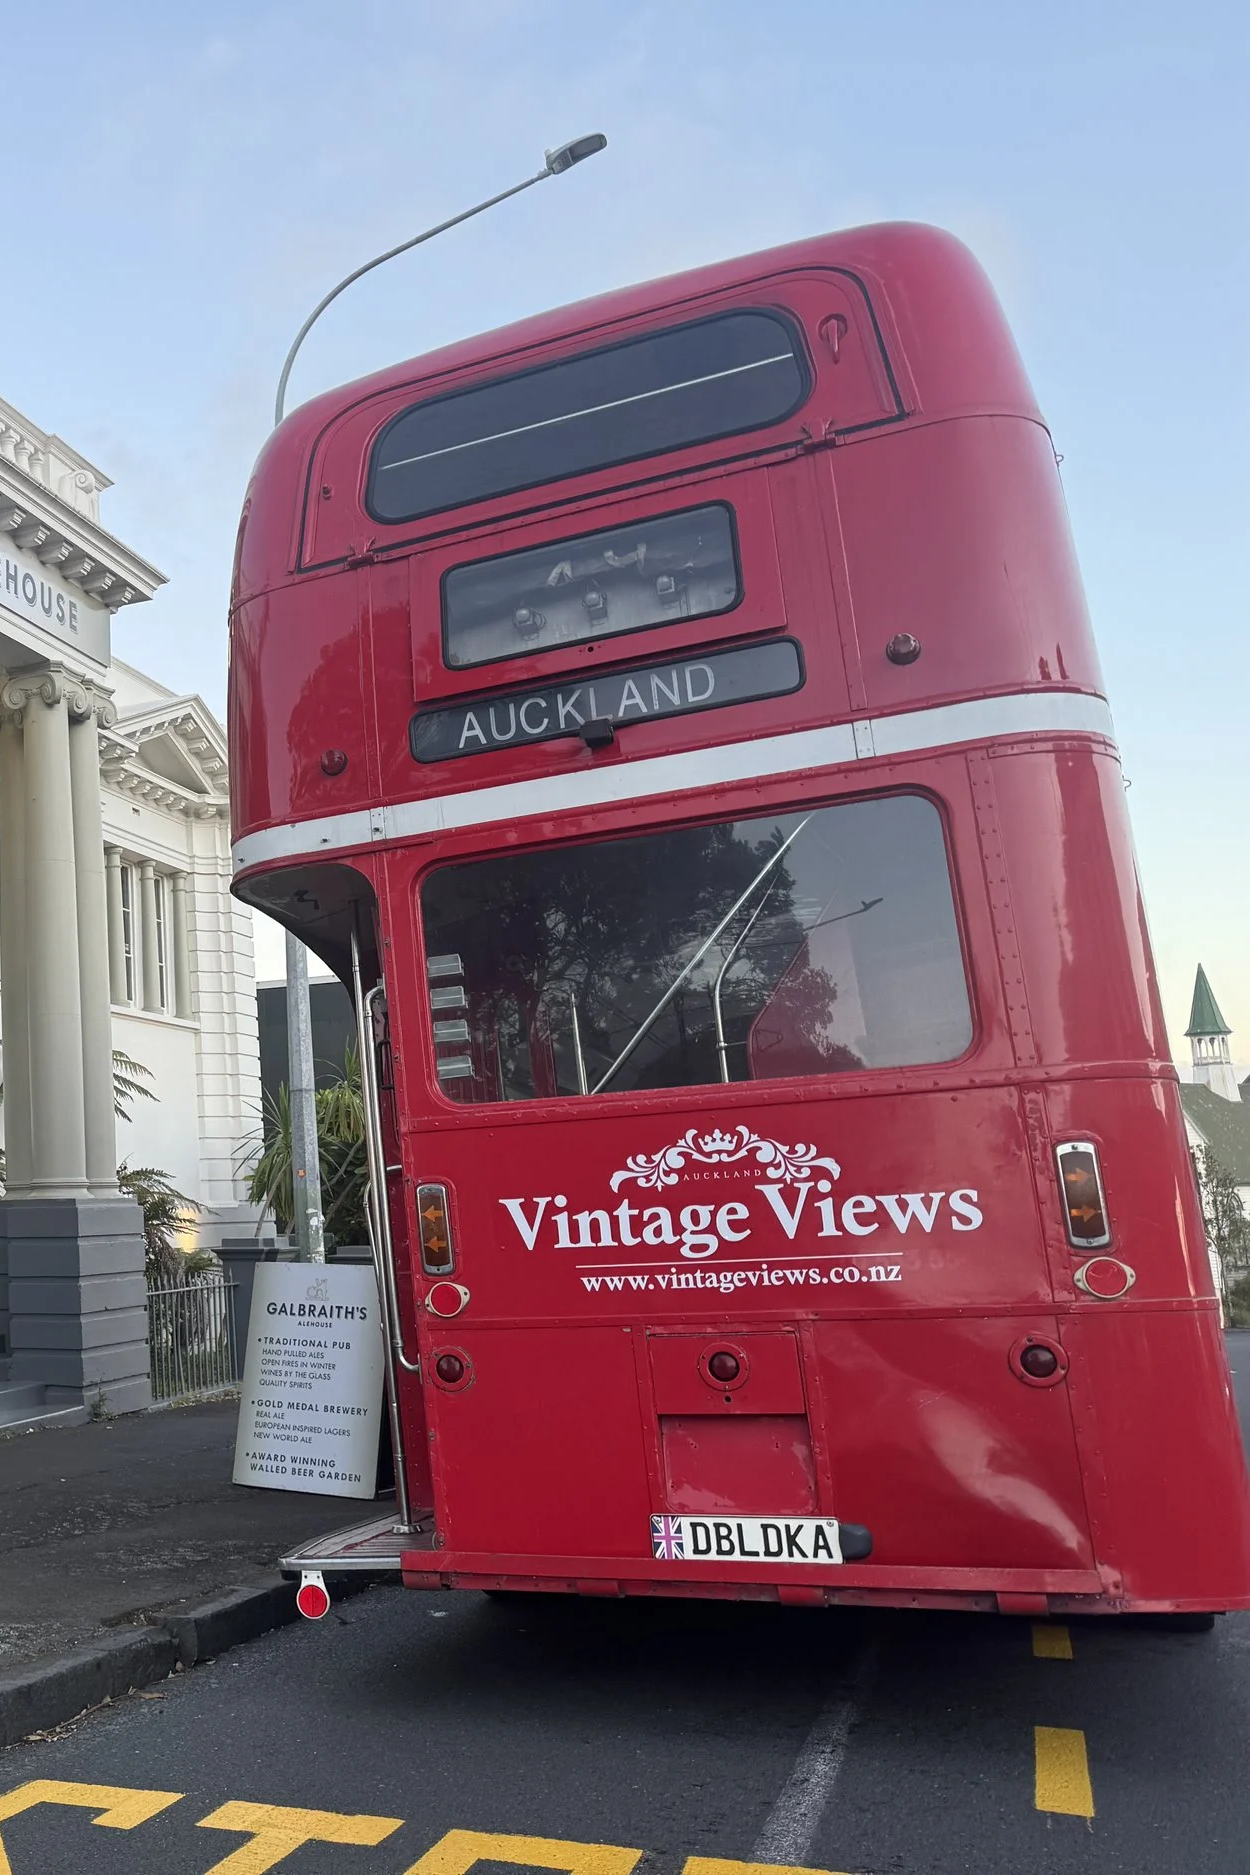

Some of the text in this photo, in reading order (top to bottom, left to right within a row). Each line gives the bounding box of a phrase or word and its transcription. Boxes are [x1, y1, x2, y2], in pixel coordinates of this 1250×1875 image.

[459, 664, 715, 749] AUCKLAND
[683, 1169, 762, 1181] AUCKLAND
[499, 1180, 984, 1258] Vintage Views
[581, 1263, 902, 1293] www.vintageviews.co.nz
[266, 1302, 368, 1320] GALBRAITH'S
[264, 1337, 351, 1349] TRADITIONAL PUB
[262, 1348, 282, 1356] HAND
[283, 1350, 307, 1358] PULLED
[261, 1358, 280, 1366] OPEN
[281, 1360, 298, 1368] FIRES
[310, 1362, 336, 1370] WINTER
[260, 1369, 282, 1377] WINES
[308, 1372, 331, 1380] GLASS
[259, 1379, 312, 1389] QUALITY SPIRITS
[257, 1399, 368, 1416] GOLD MEDAL BREWERY
[273, 1412, 285, 1420] ALE
[254, 1421, 351, 1436] EUROPEAN INSPIRED LAGERS
[272, 1433, 299, 1442] WORLD
[251, 1452, 336, 1468] AWARD WINNING
[250, 1463, 361, 1482] WALLED BEER GARDEN
[690, 1522, 834, 1558] DBLDKA
